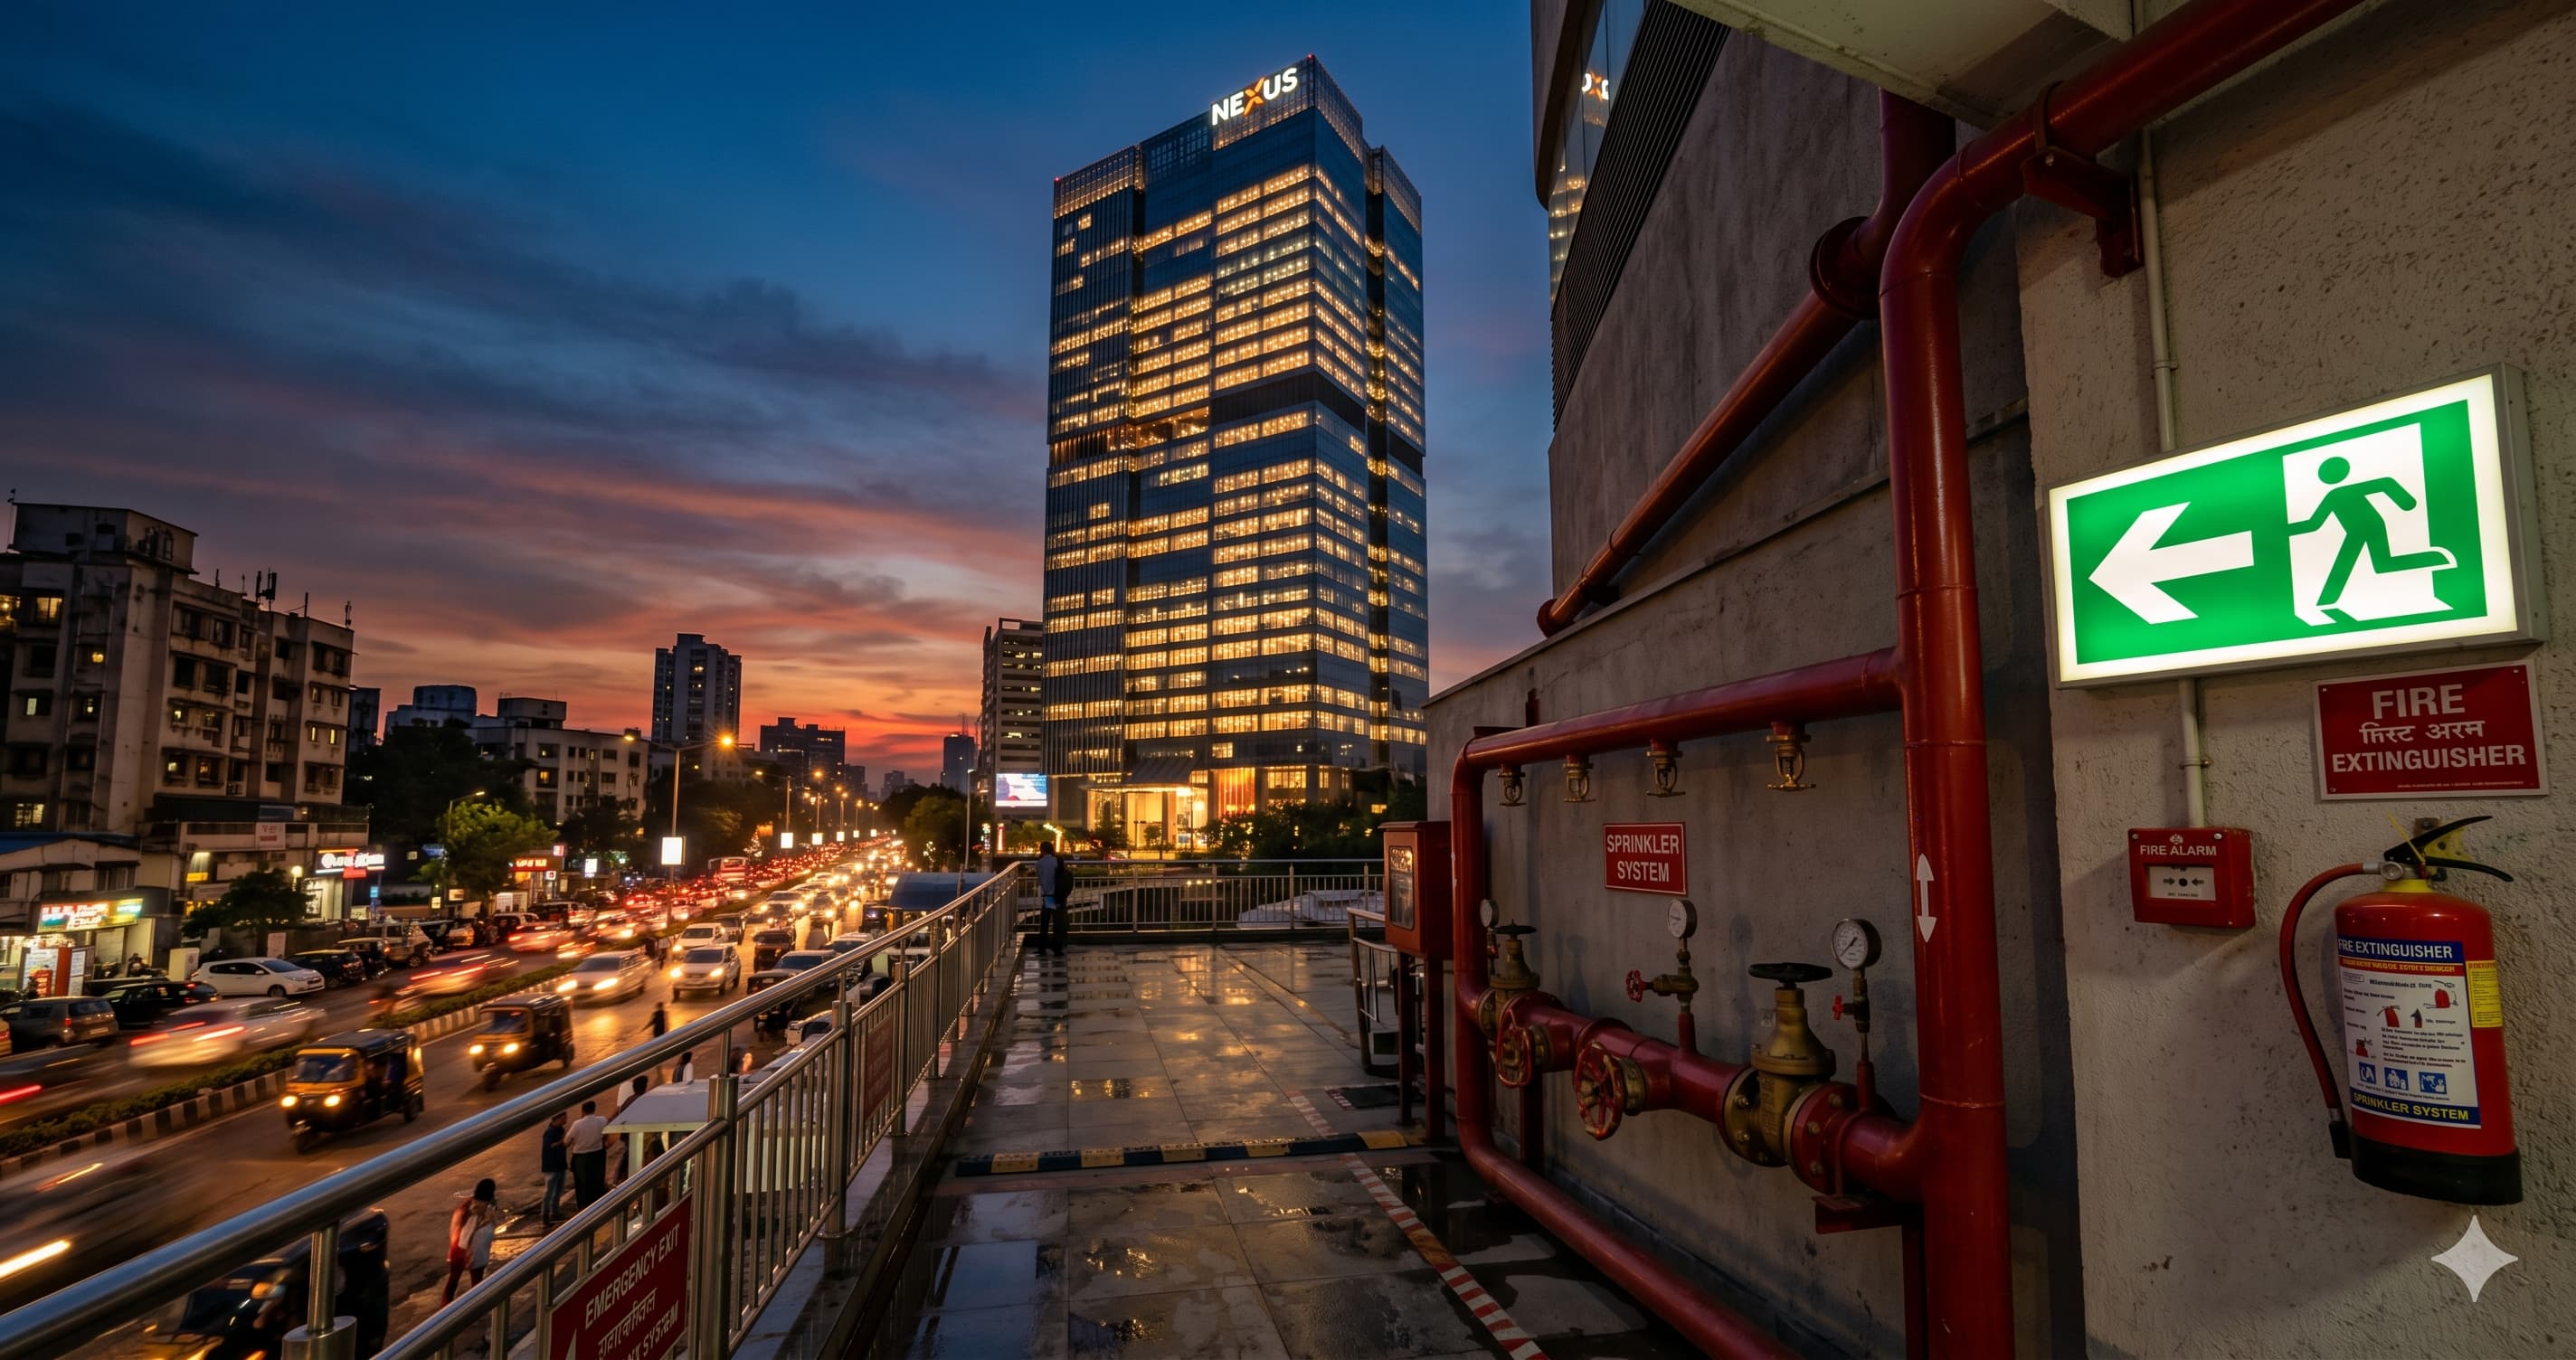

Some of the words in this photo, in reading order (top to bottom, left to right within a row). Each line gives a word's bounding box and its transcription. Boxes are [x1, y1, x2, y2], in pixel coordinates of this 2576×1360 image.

[1212, 68, 1298, 126] NEXUS
[2372, 684, 2466, 719] FIRE
[2332, 744, 2526, 773] EXTINGUISHER
[1606, 834, 1680, 855] SPRINKLER
[2140, 845, 2167, 855] FIRE
[2170, 845, 2218, 856] ALARM
[1617, 860, 1670, 883] SYSTEM
[2355, 940, 2453, 959] EXTINGUISHER
[2353, 1092, 2410, 1113] SPRINKLER
[2412, 1105, 2469, 1120] SYSTEM
[585, 1244, 657, 1331] EMERGENCY
[658, 1223, 680, 1262] EXIT
